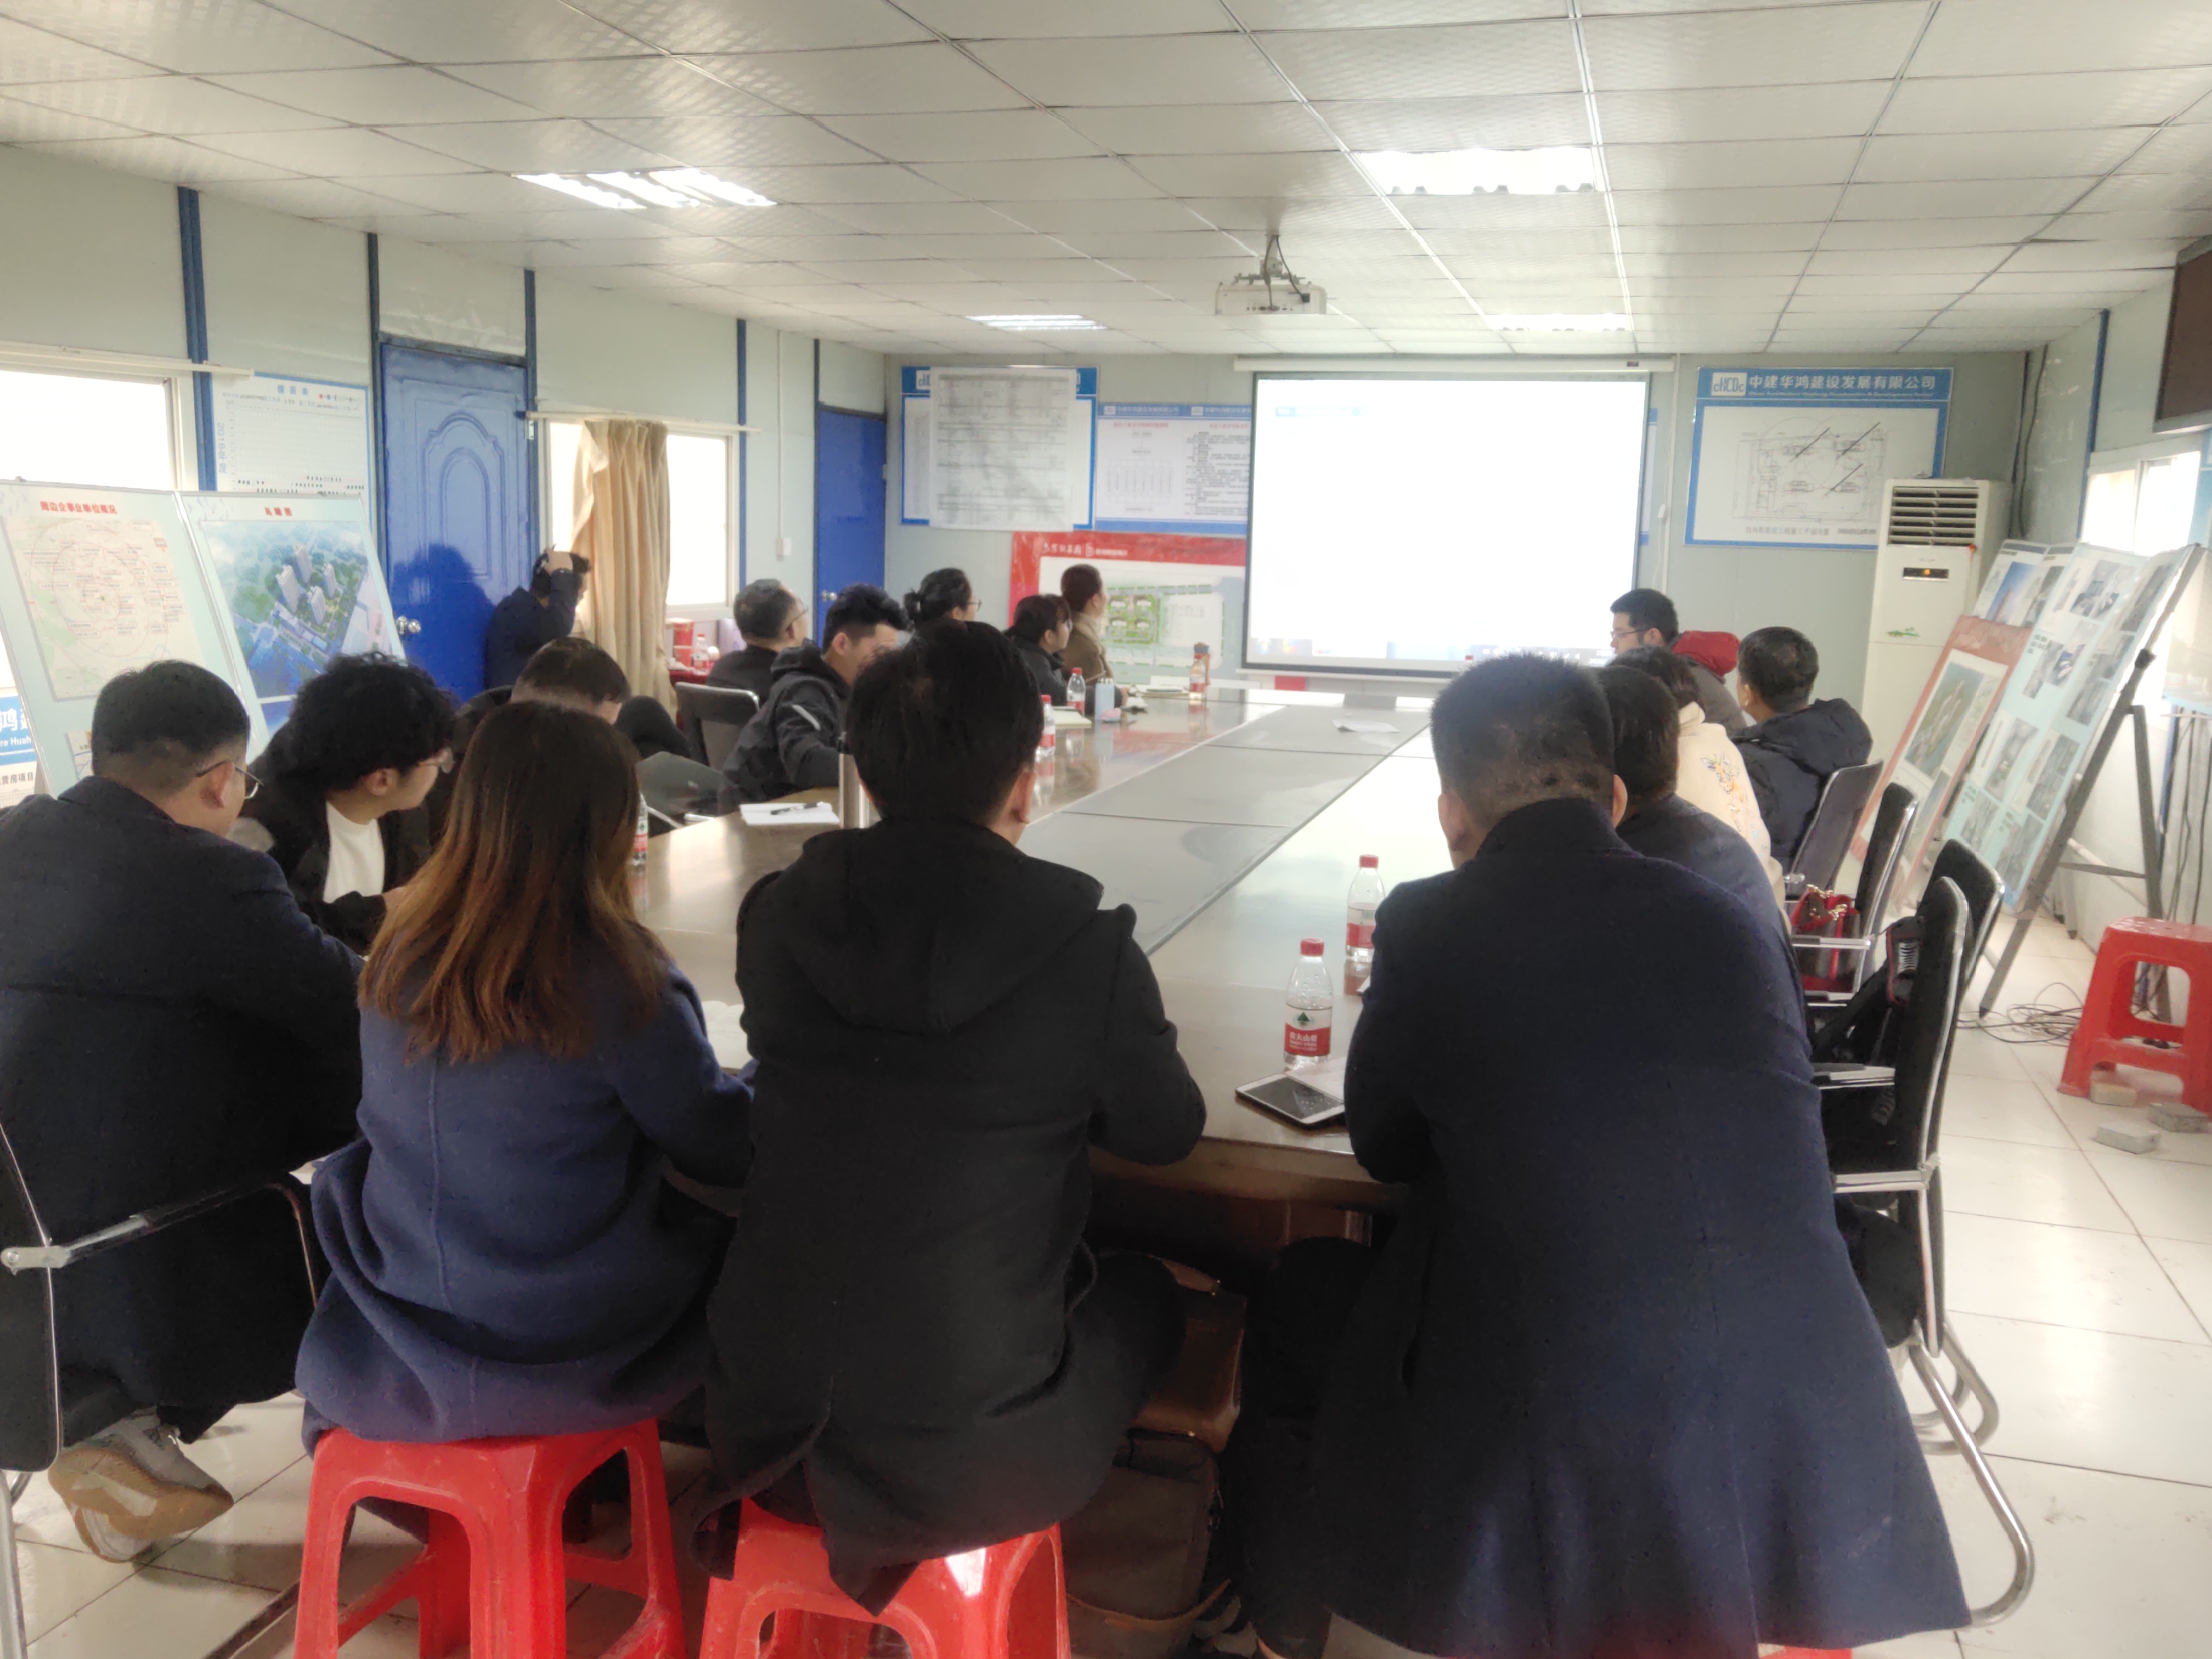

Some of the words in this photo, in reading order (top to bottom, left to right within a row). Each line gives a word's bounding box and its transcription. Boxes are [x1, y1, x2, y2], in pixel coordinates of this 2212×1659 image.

[1750, 375, 1936, 389] 中建华鸿建设发展有限公司
[0, 772, 33, 785] 赁房项目
